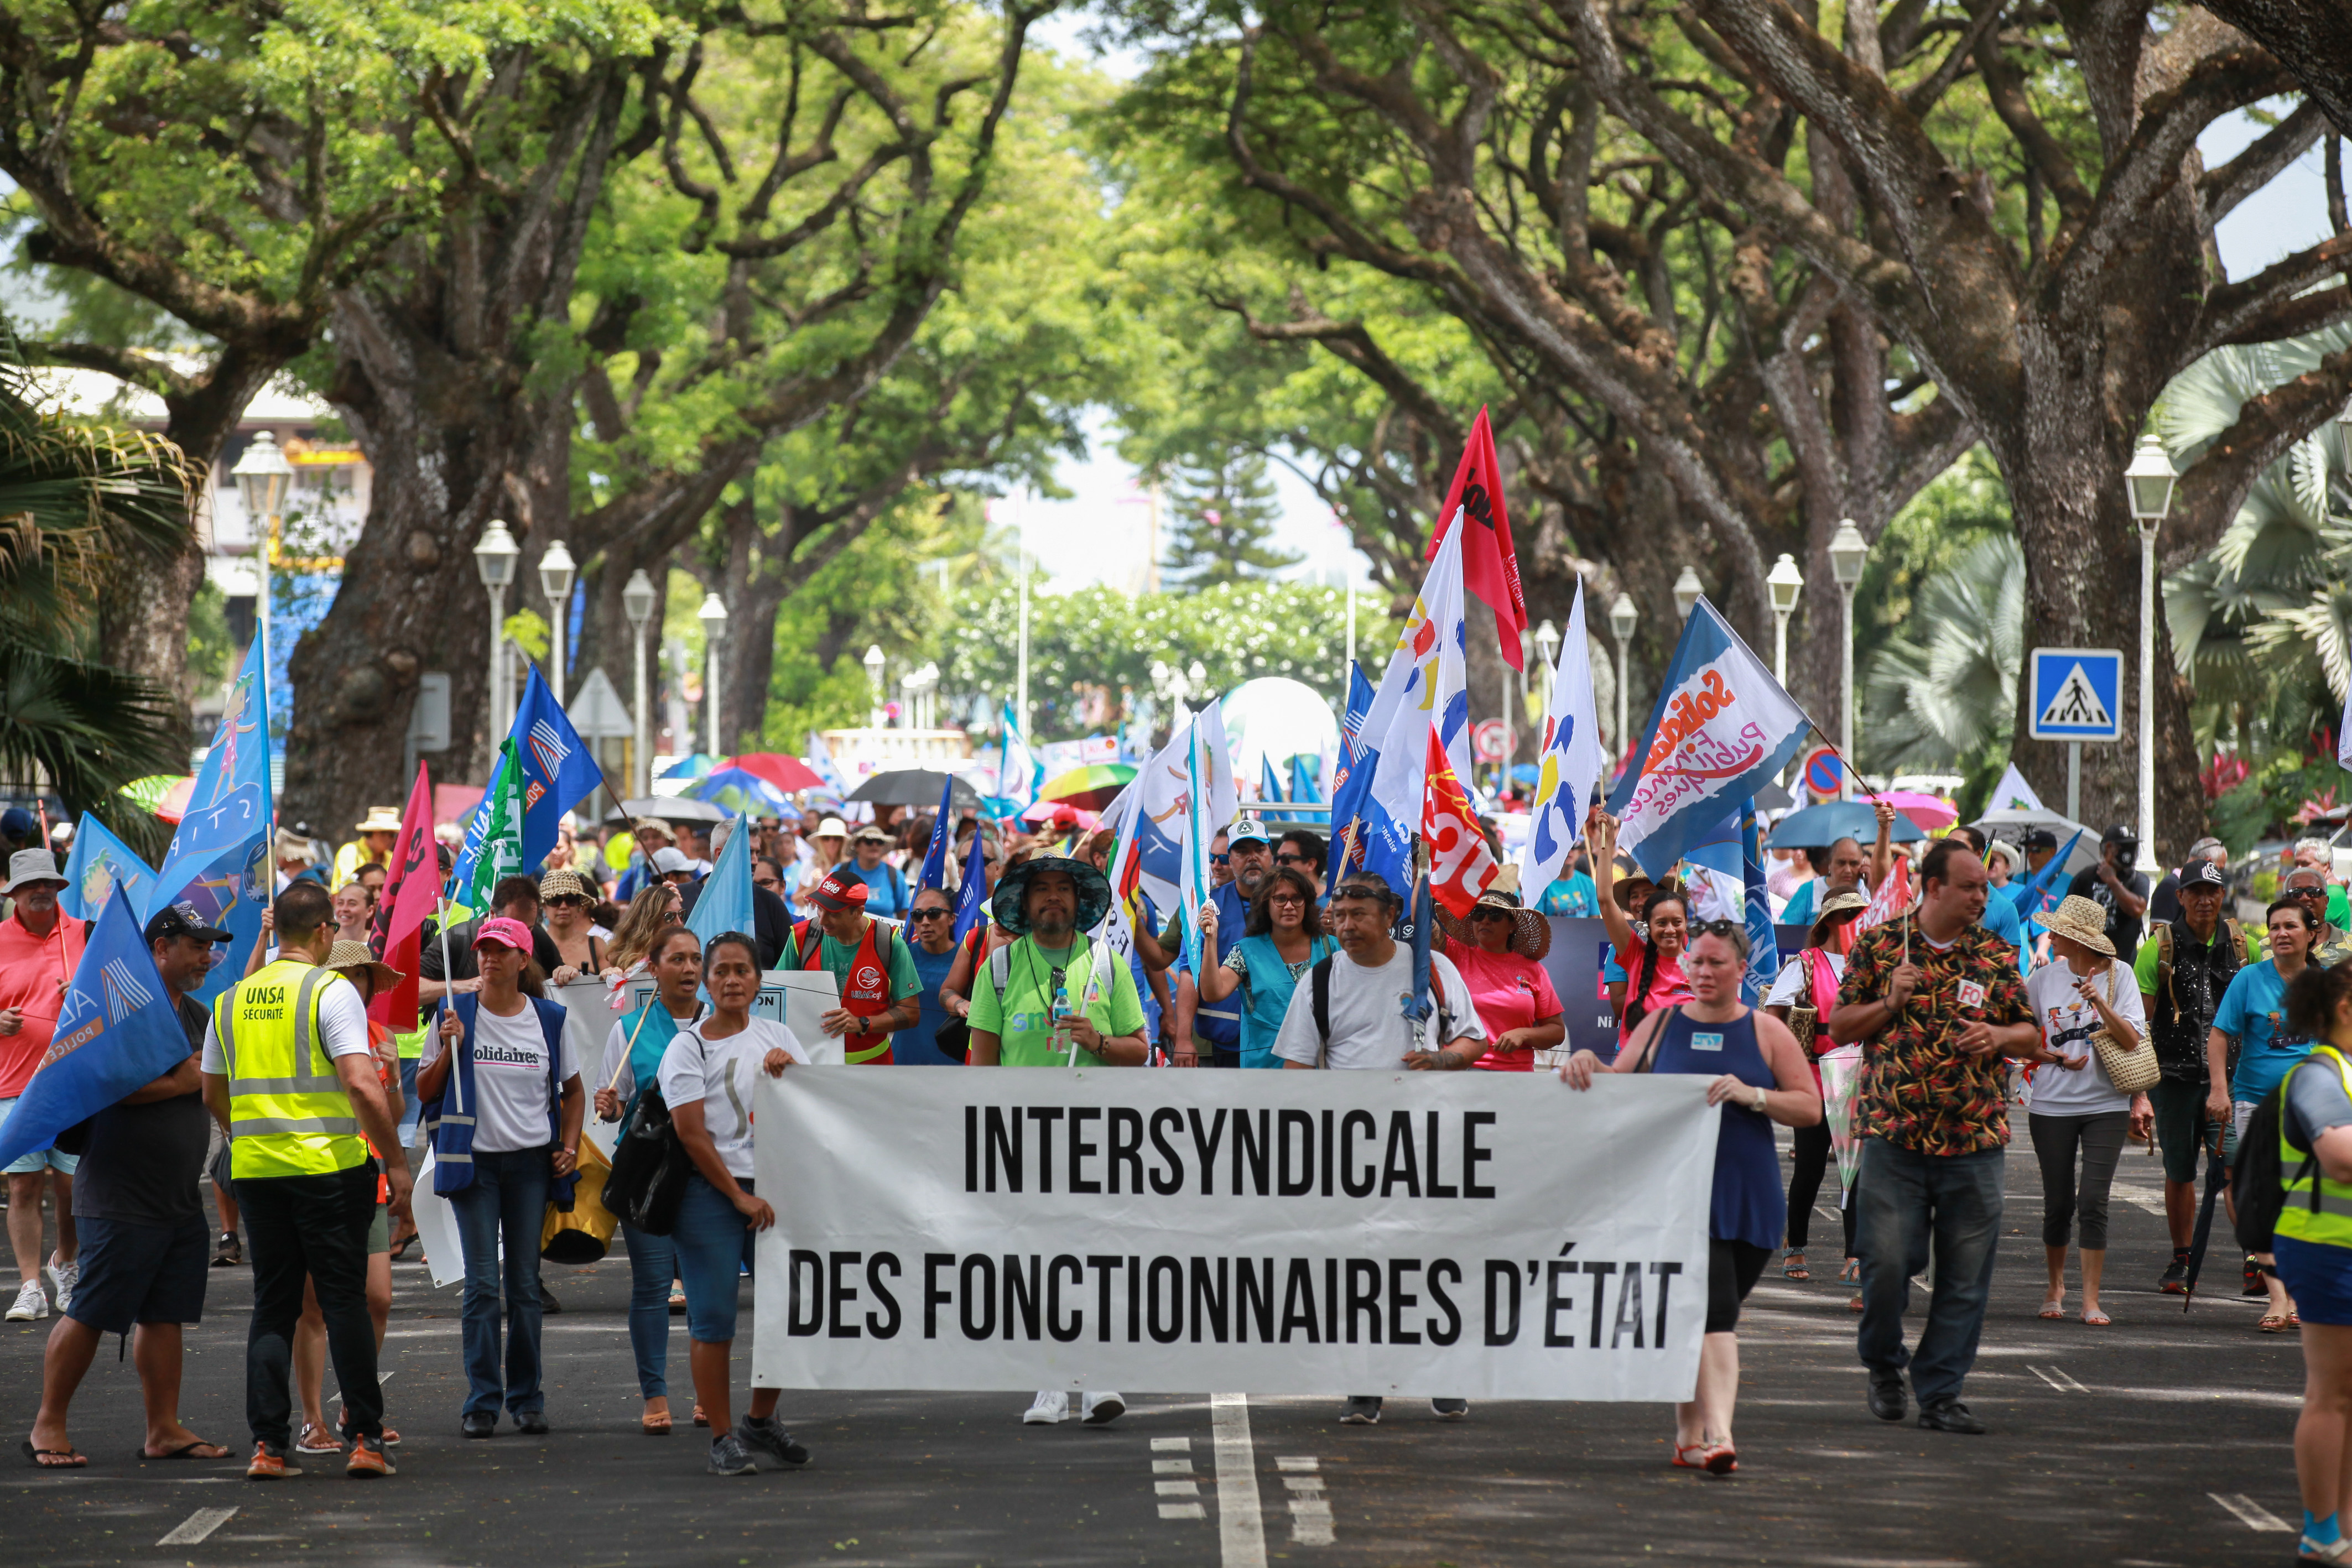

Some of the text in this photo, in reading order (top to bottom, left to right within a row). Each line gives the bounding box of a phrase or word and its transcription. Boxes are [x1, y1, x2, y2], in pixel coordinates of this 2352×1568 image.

[1381, 824, 1397, 853] ançaise
[246, 986, 284, 1004] UNSA
[1960, 985, 1980, 1004] FO
[243, 1006, 283, 1020] SÉCURITÉ
[1597, 1016, 1612, 1028] Ni
[473, 1045, 539, 1063] olidaires
[965, 1106, 1496, 1198] INTERSYNDICALE
[788, 1242, 1683, 1348] DES FONCTIONNAIRES D'ÉTAT
